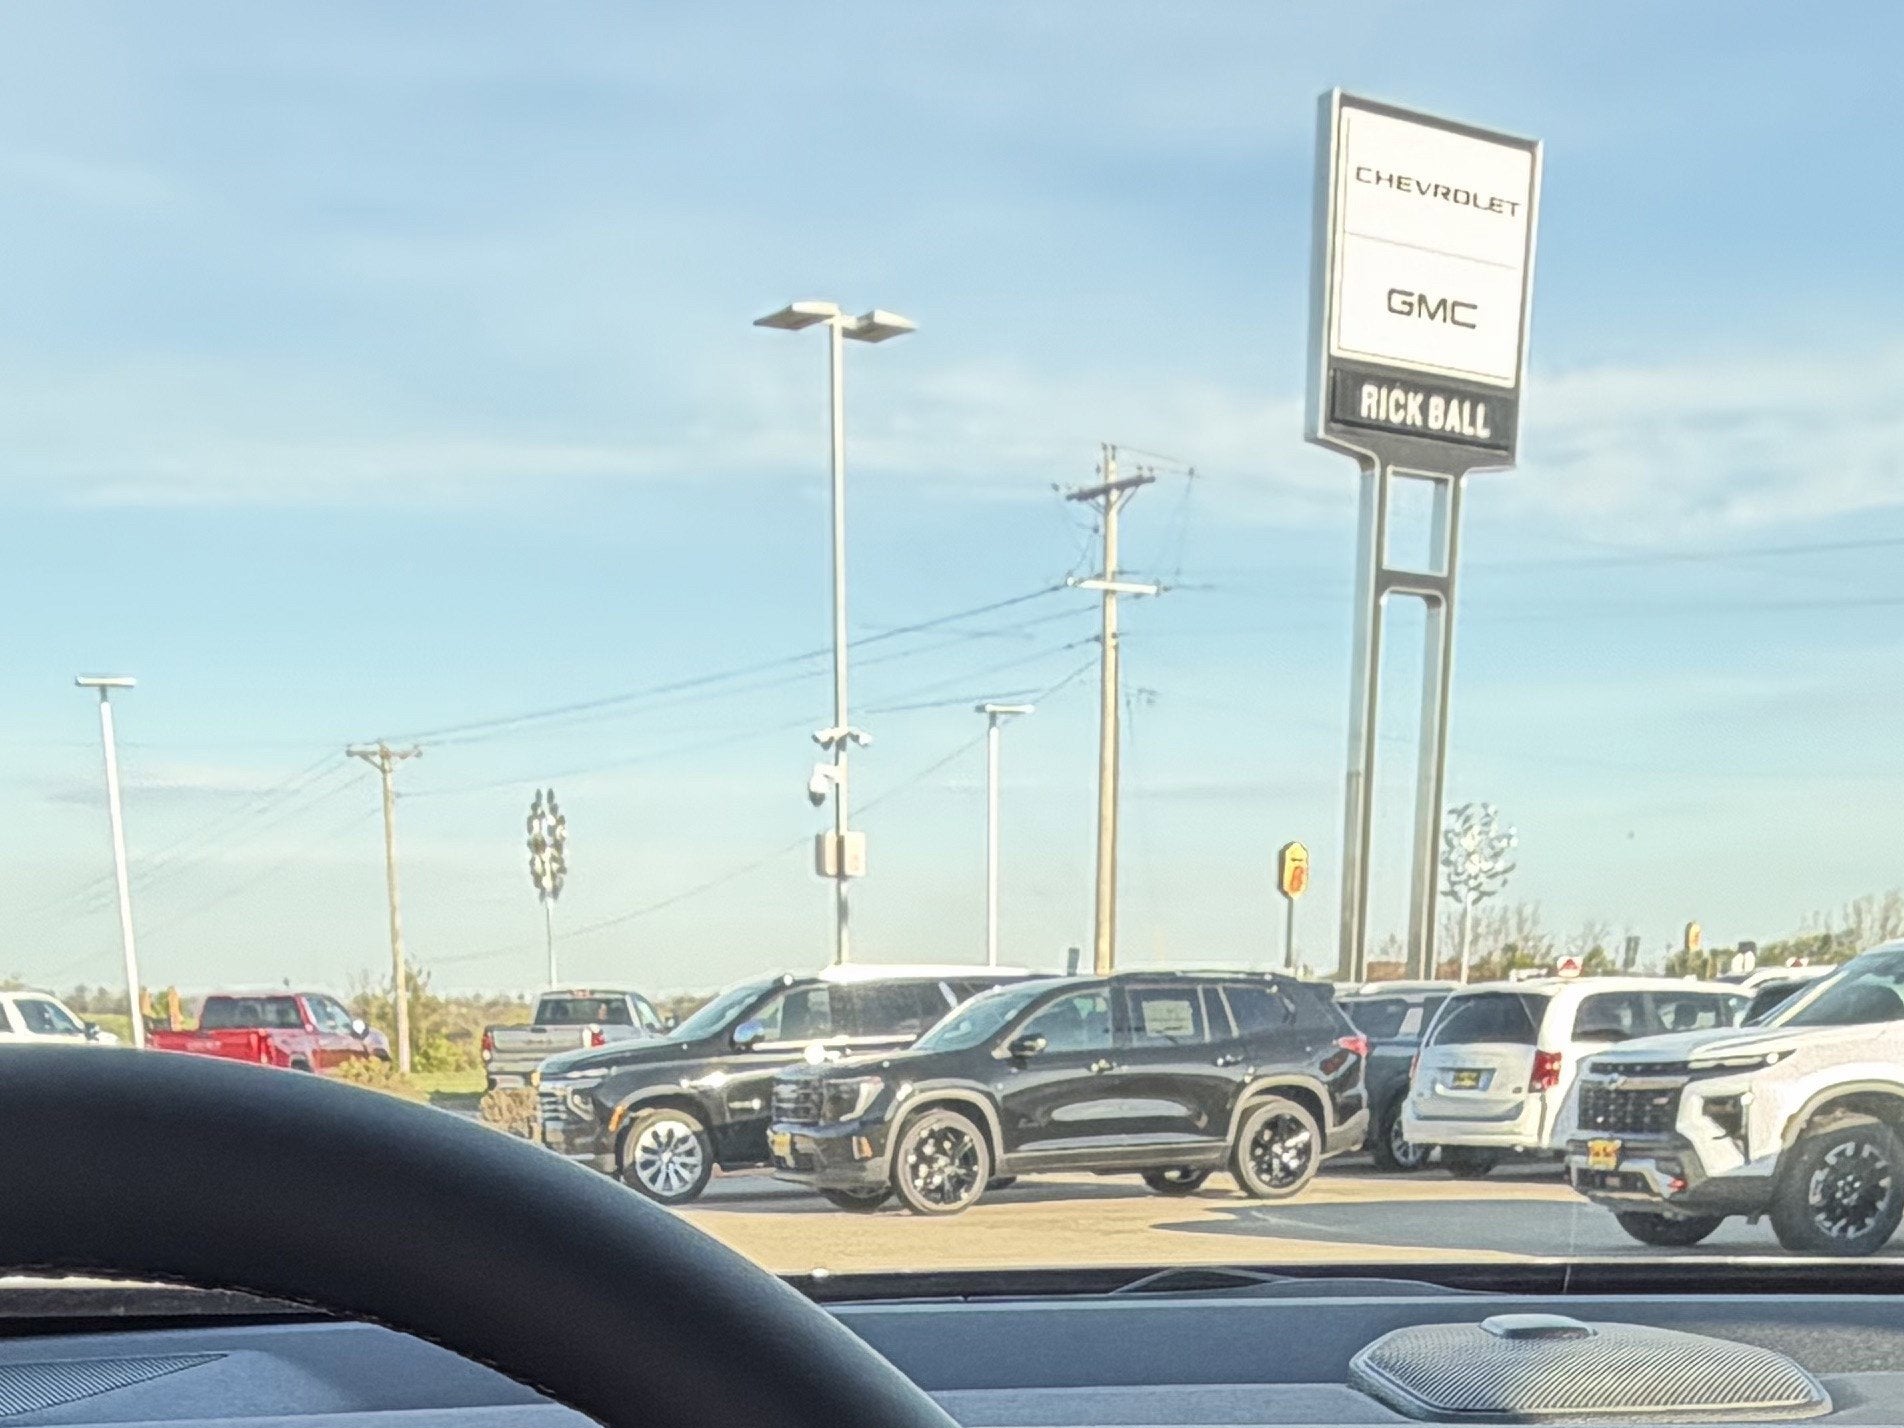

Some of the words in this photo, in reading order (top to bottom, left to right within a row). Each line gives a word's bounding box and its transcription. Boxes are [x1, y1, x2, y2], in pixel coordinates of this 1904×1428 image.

[1356, 166, 1520, 217] CHEVROLET
[1387, 288, 1478, 329] GMC
[1361, 384, 1423, 426] RICK
[1428, 398, 1491, 439] BALL
